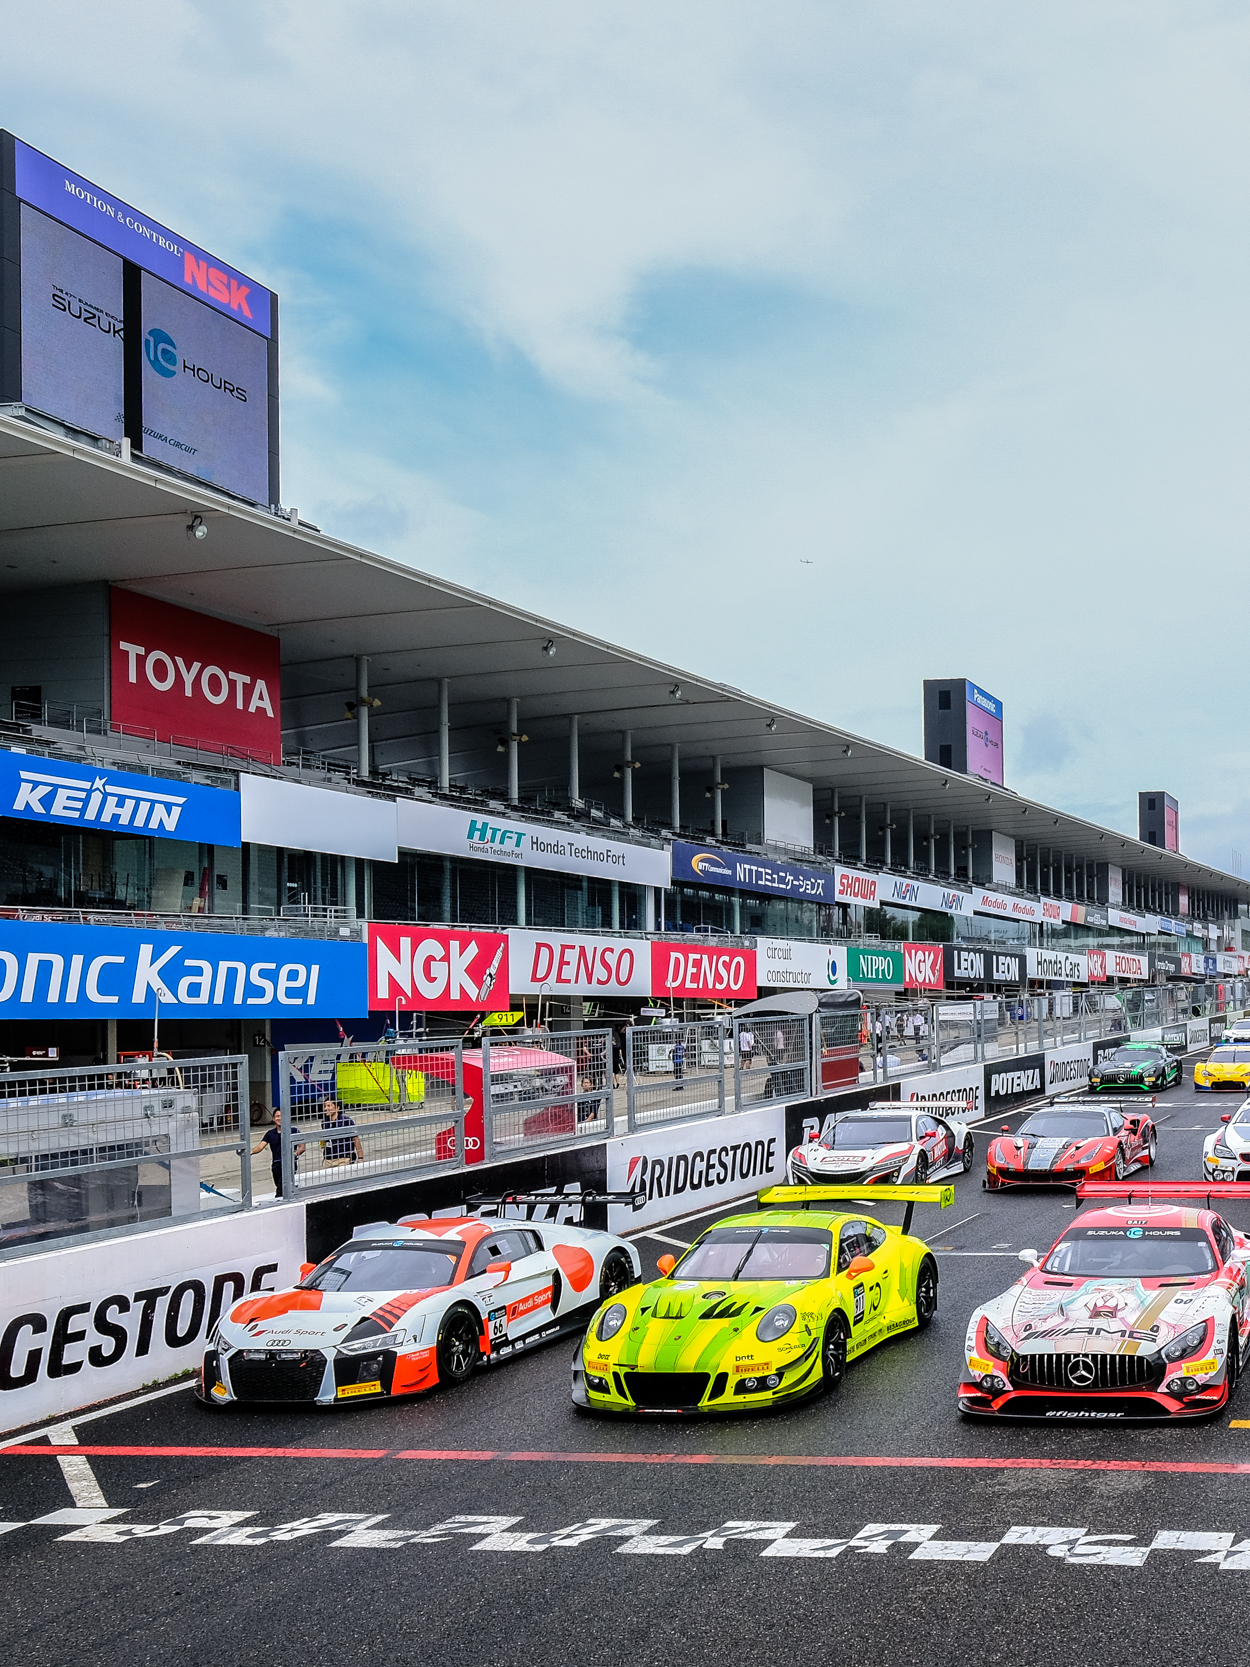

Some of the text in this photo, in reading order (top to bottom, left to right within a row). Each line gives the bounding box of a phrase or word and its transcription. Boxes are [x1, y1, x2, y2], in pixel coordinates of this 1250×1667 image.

[64, 180, 115, 218] MOTION
[117, 211, 125, 225] &
[184, 251, 253, 319] NSK
[183, 359, 247, 403] HOURS
[168, 437, 198, 456] CIRCUIT
[119, 641, 274, 718] TOYOTA
[973, 688, 996, 713] Panasonic
[12, 775, 184, 832] KEIHIN
[469, 843, 490, 854] Honda
[530, 835, 566, 856] Honda
[736, 862, 825, 896] NTTコミュニケーションズ
[838, 873, 877, 901] SHOWA
[980, 895, 1008, 911] Modulo
[1012, 902, 1036, 917] Modulo
[1042, 901, 1061, 919] SHOWA
[766, 941, 792, 961] circuit
[376, 936, 482, 1001] NGK
[530, 941, 635, 987] DENSO
[666, 951, 745, 992] DENSO
[859, 954, 893, 980] NIPPO
[905, 949, 936, 985] NGK
[954, 950, 984, 979] LEON
[993, 954, 1019, 982] LEON
[1036, 952, 1081, 979] Honda Cars
[1088, 954, 1104, 978] NGK
[1114, 955, 1142, 976] HONDA
[766, 969, 812, 986] constructor
[497, 1012, 516, 1023] 911
[255, 1036, 265, 1046] 12
[990, 1068, 1040, 1097] POTENZA
[1049, 1058, 1090, 1085] BRIDGESTONE
[628, 1137, 777, 1199] BRIDGESTONE
[518, 1290, 552, 1312] Audi Sport
[267, 1328, 327, 1338] Audi Sport
[493, 1319, 504, 1336] 66
[588, 1361, 609, 1372] PIRELLI
[735, 1354, 754, 1362] bott
[735, 1363, 770, 1373] PIRELLI
[969, 1359, 990, 1372] PIRELLI
[1185, 1361, 1215, 1374] PIRELLI
[1045, 1410, 1125, 1418] #fightgsr
